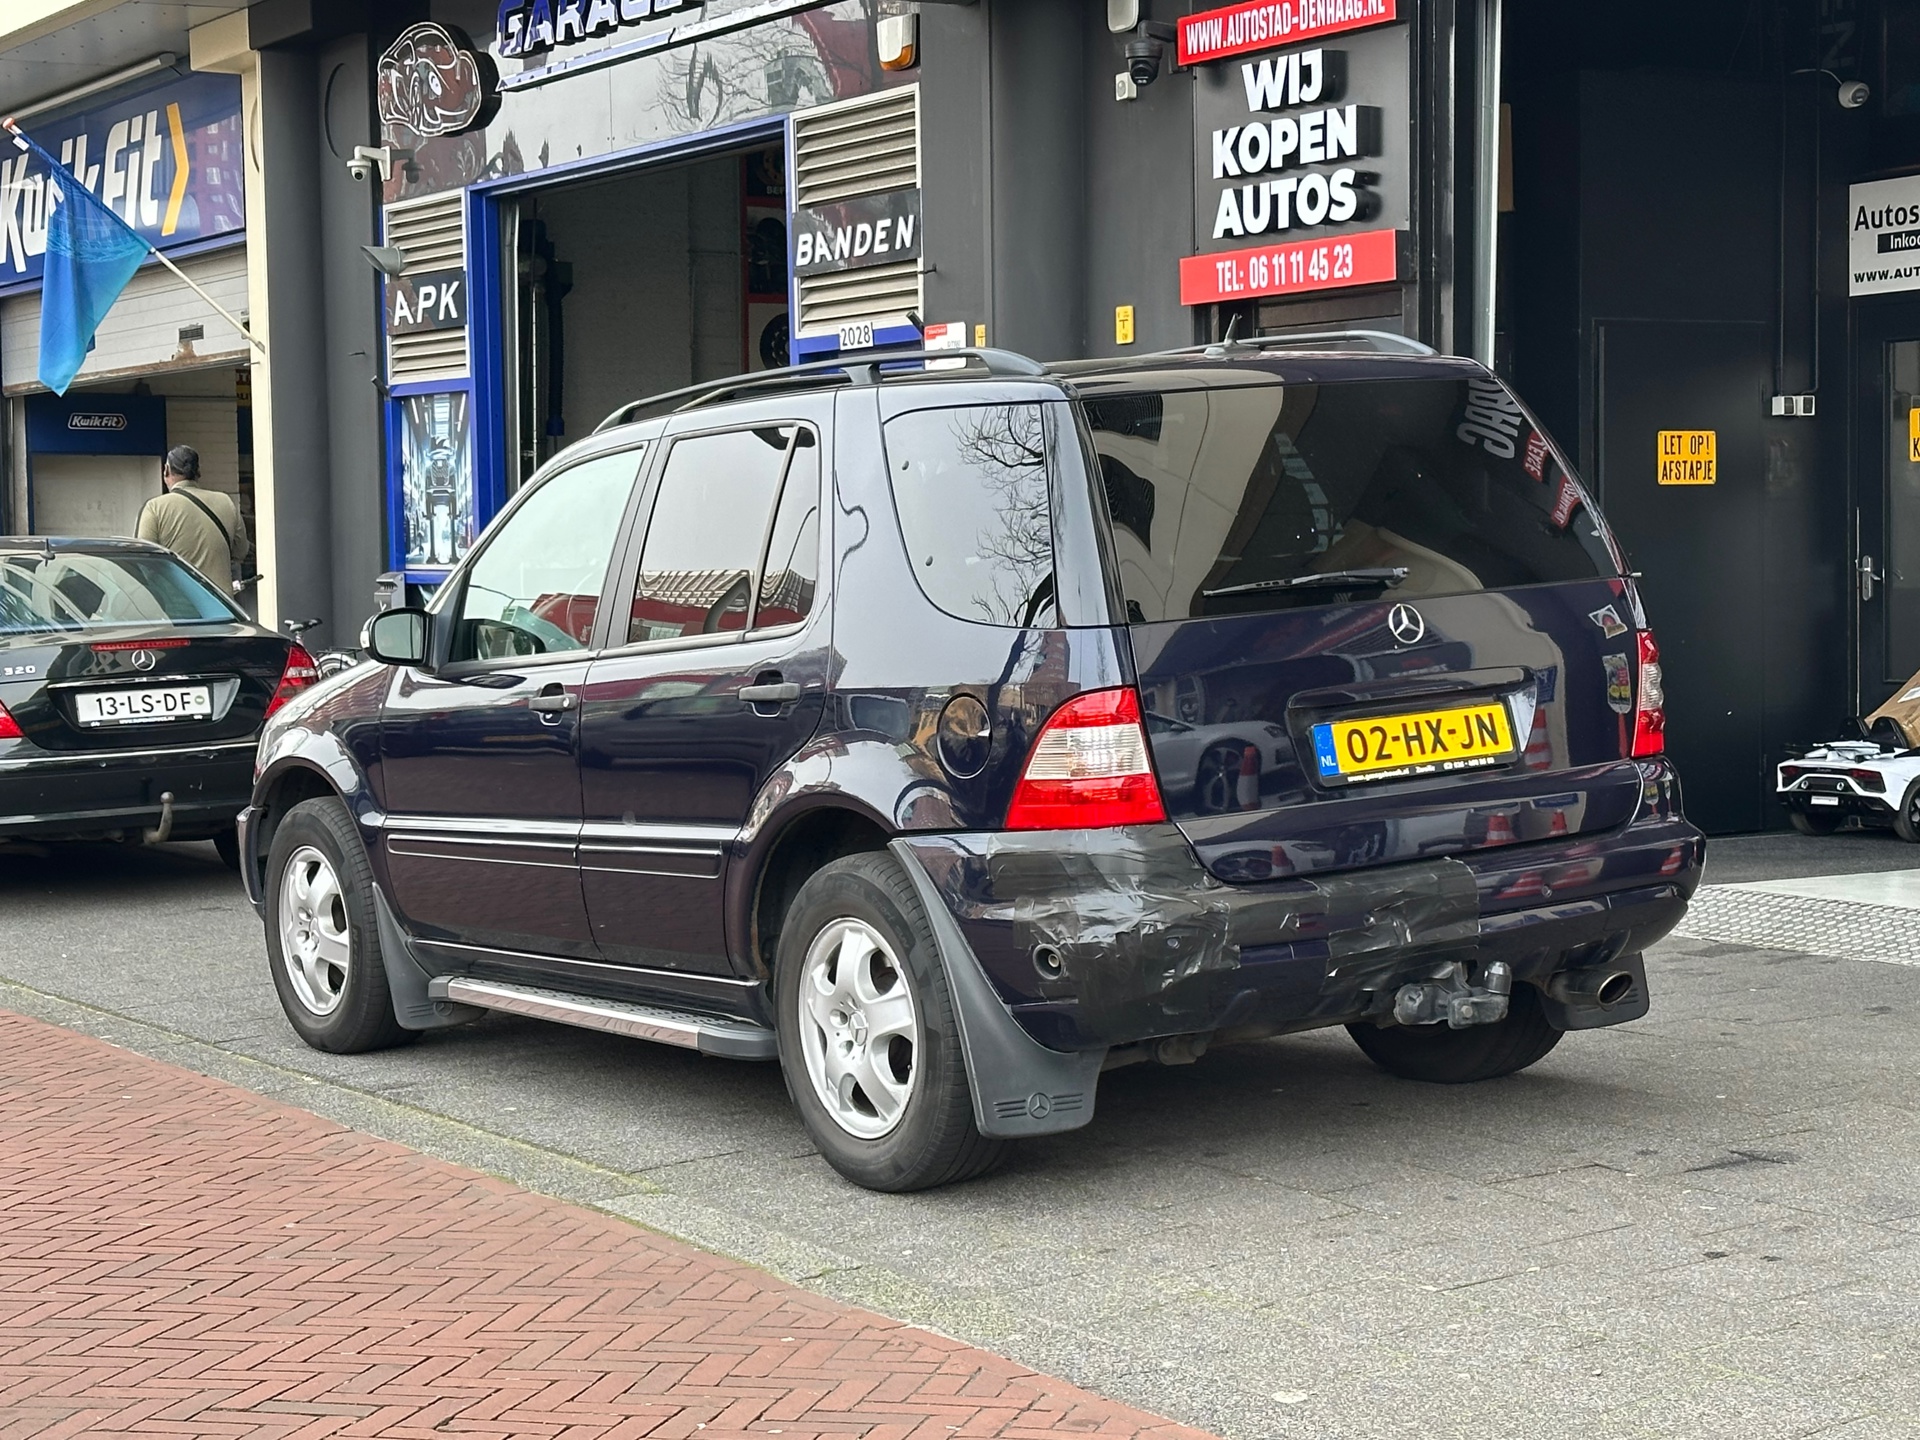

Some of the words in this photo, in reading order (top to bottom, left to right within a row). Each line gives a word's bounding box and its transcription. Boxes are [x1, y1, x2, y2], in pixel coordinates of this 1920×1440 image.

[498, 0, 683, 57] GARA
[1241, 48, 1323, 112] WIJ
[1212, 104, 1357, 179] KOPEN
[1212, 168, 1357, 239] AUTOS
[796, 214, 915, 267] BANDEN
[1216, 259, 1244, 293] TEL:
[1249, 255, 1268, 290] 06
[1272, 252, 1286, 286] 11
[1290, 250, 1304, 284] 11
[1308, 247, 1329, 282] 45
[1333, 243, 1353, 279] 23
[393, 281, 460, 327] APK
[840, 325, 871, 347] 2028
[1664, 434, 1682, 455] LET
[1690, 434, 1710, 455] OP!
[1661, 460, 1713, 481] AFSTAPJE
[95, 692, 192, 716] 13-LS-DF
[1321, 754, 1337, 767] NL
[1346, 712, 1500, 764] 02-HX-JN
